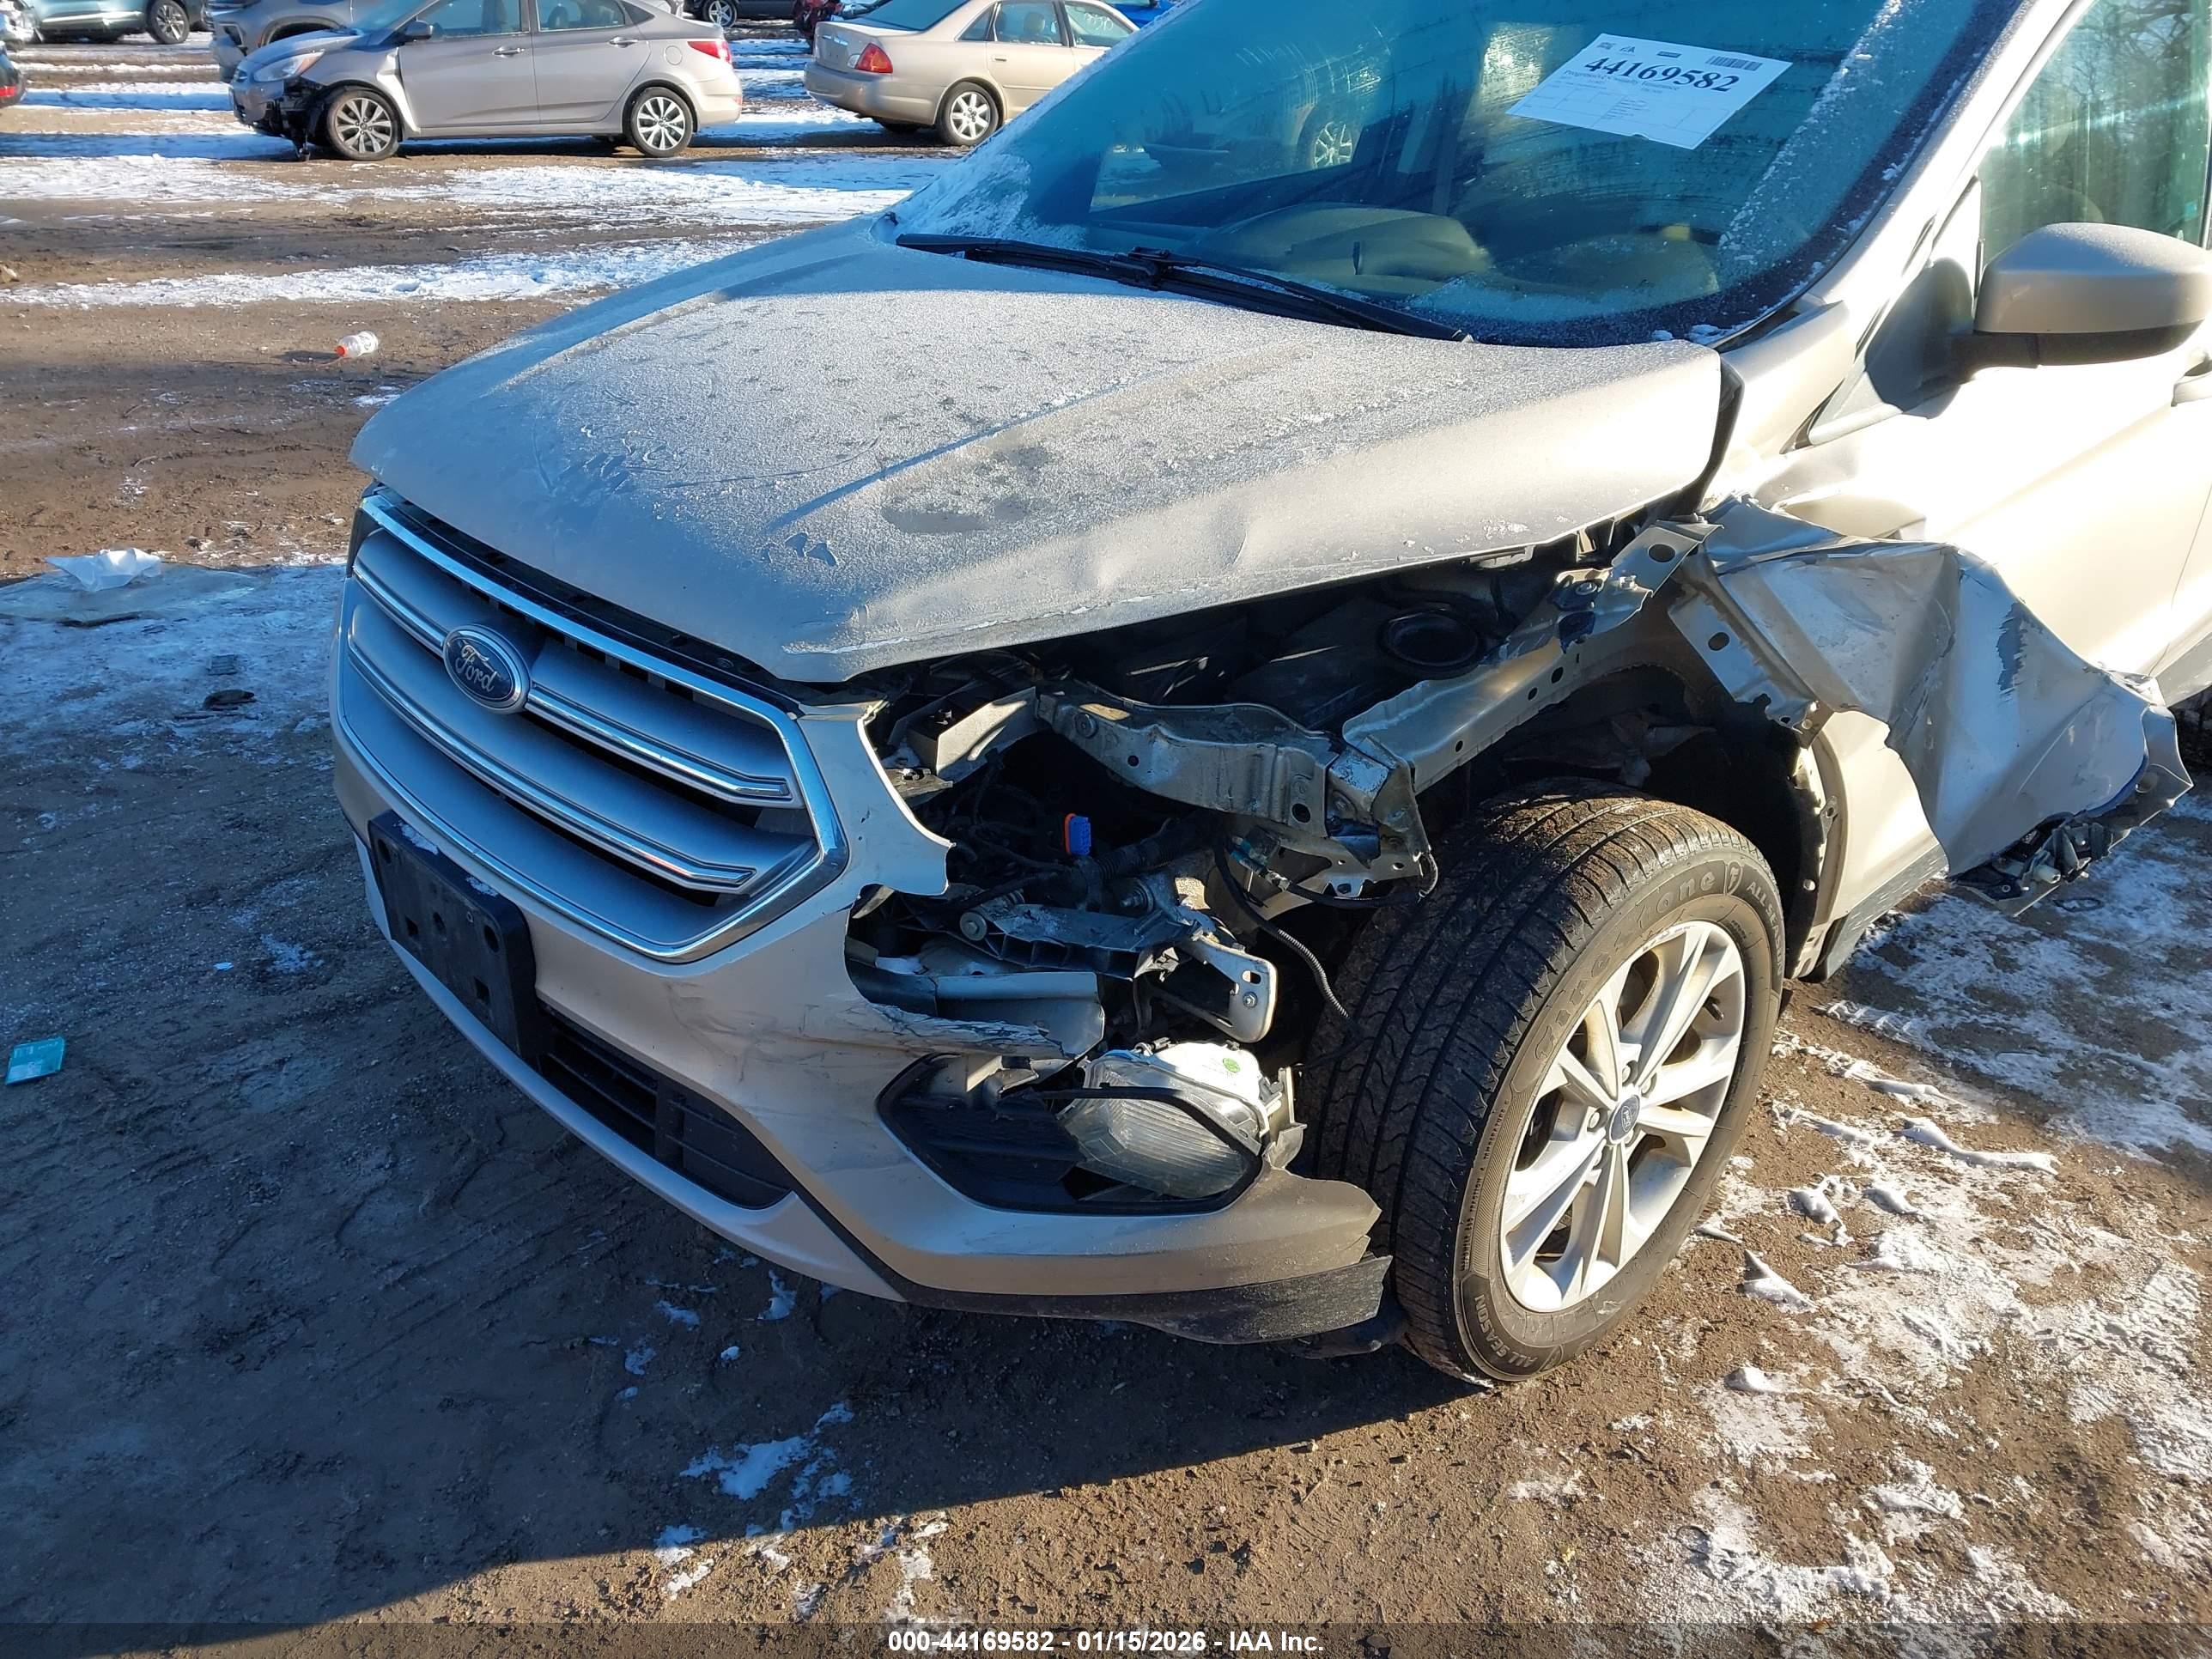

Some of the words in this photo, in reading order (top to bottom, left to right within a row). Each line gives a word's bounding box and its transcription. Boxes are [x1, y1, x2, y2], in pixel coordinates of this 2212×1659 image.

[1584, 57, 1741, 92] 44169582
[454, 641, 496, 692] Ford
[1746, 881, 1767, 907] ALL
[1474, 1294, 1511, 1358] SEASON
[1507, 1347, 1539, 1368] ALL
